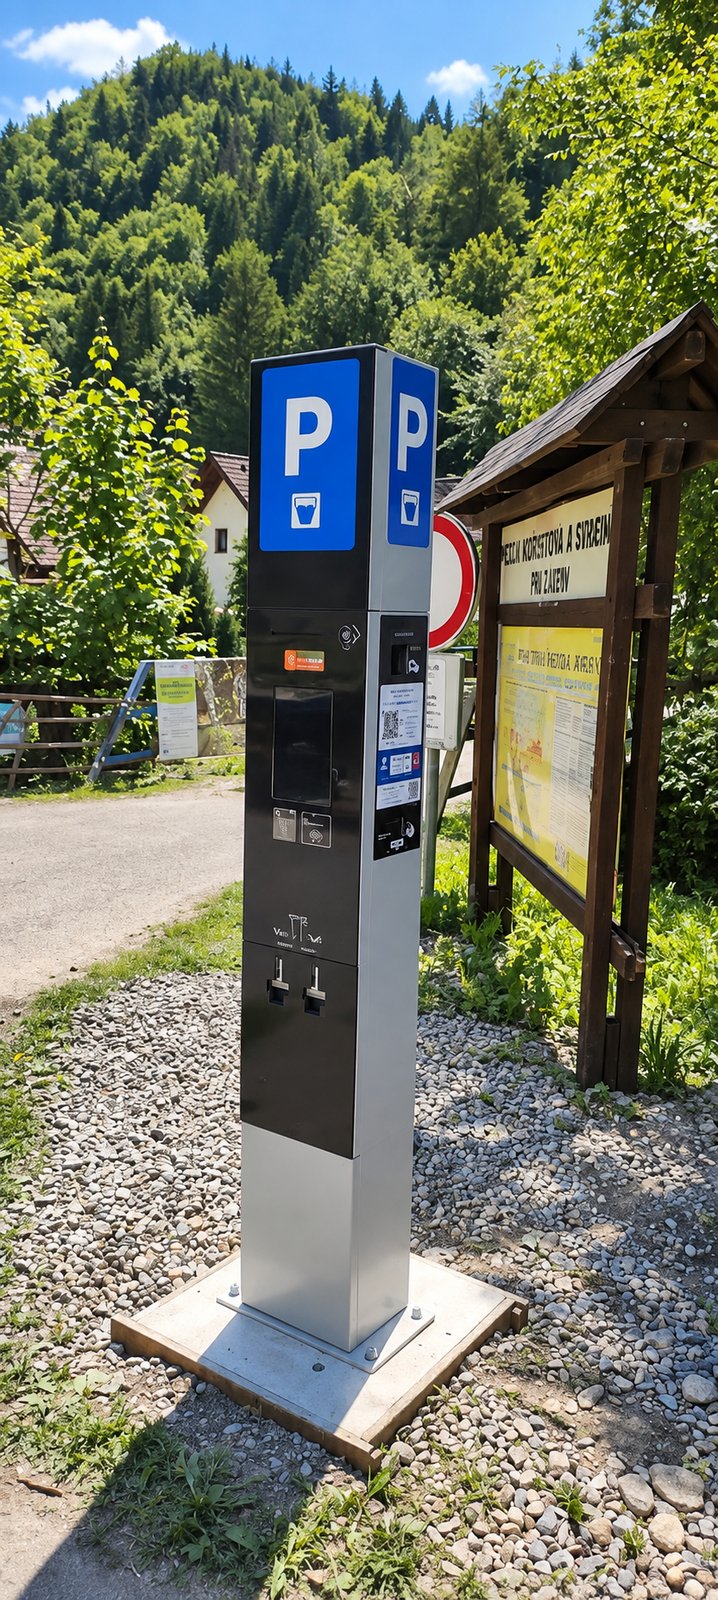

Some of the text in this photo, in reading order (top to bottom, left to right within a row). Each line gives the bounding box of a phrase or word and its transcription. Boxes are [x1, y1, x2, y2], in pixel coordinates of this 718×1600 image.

[285, 396, 333, 476] P
[397, 392, 428, 472] P
[566, 525, 573, 553] A
